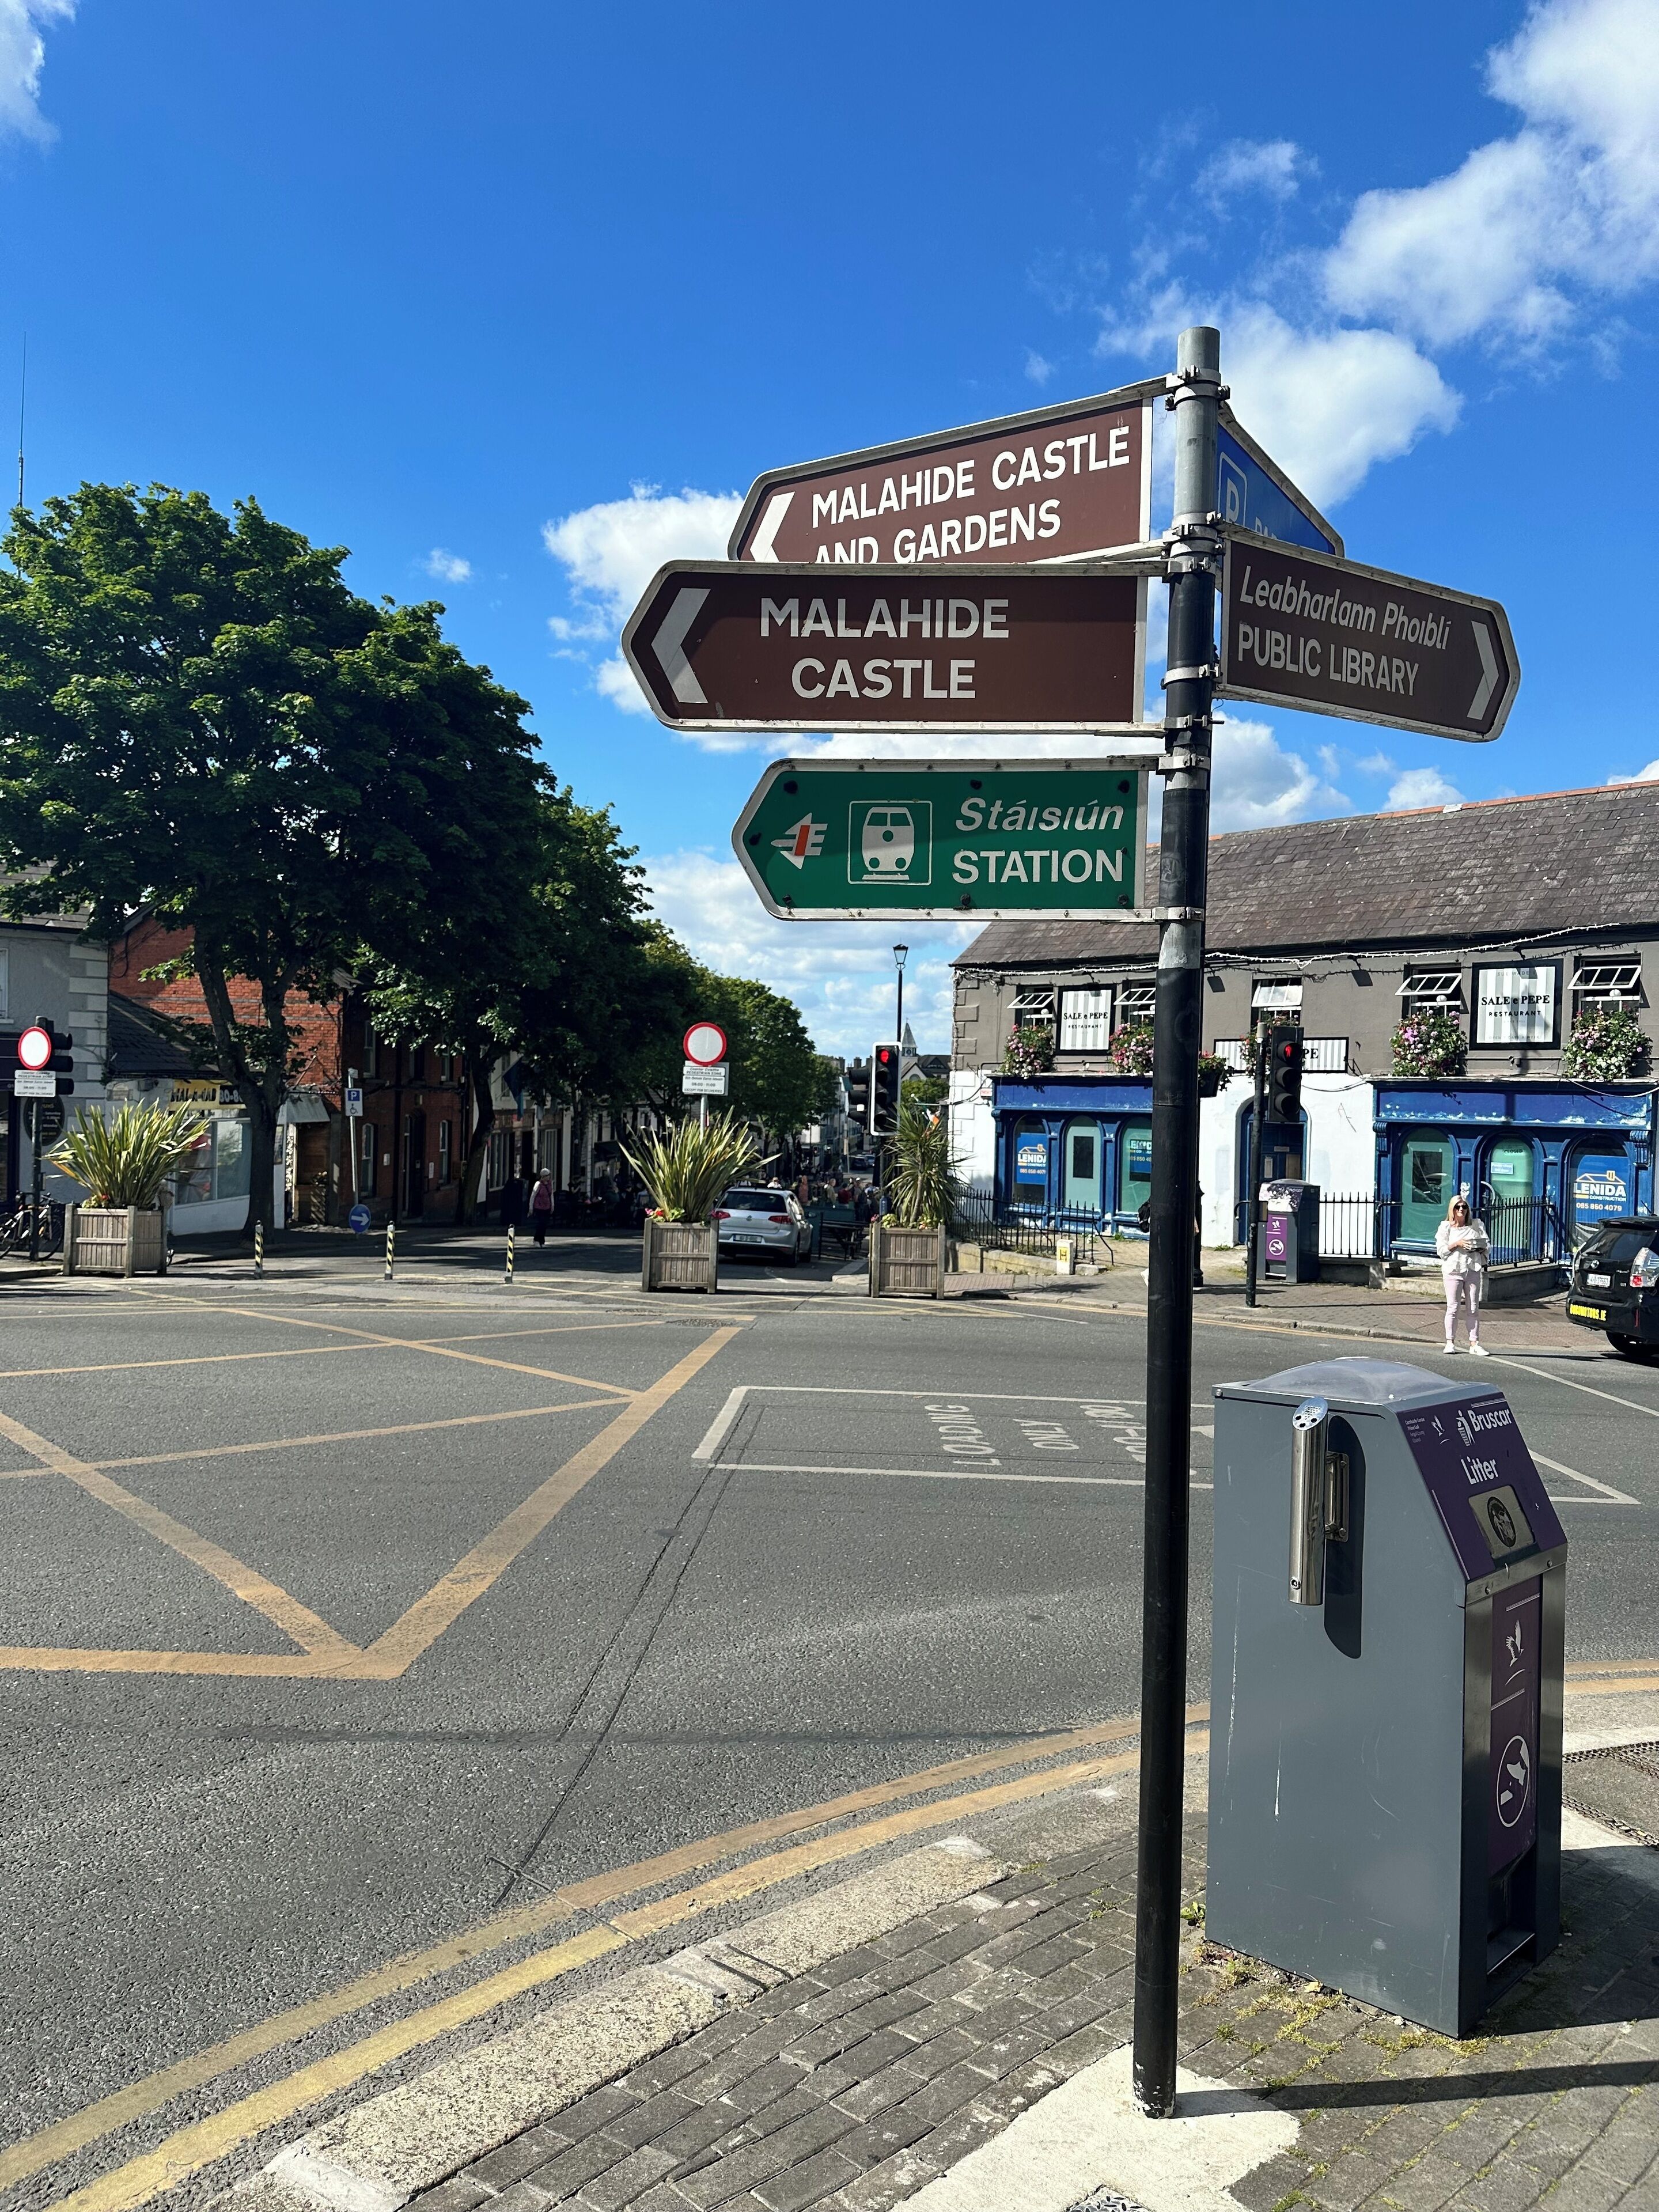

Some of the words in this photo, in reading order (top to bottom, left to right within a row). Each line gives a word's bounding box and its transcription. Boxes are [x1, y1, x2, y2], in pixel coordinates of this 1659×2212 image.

[812, 459, 975, 529] MALAHIDE
[991, 426, 1130, 490] CASTLE
[893, 499, 1060, 563] GARDENS
[1239, 565, 1376, 633] Leabharlann
[760, 599, 1010, 638] MALAHIDE
[1238, 623, 1321, 677] PUBLIC
[1329, 643, 1419, 696] LIBRARY
[791, 658, 976, 699] CASTLE
[952, 849, 1123, 884] STATION
[1481, 997, 1510, 1006] SALE
[1521, 995, 1550, 1004] PEPE
[1303, 1048, 1319, 1059] PE
[350, 1091, 357, 1100] P
[1573, 1183, 1627, 1197] LENIDA
[925, 1404, 1002, 1465] LOADING
[1012, 1418, 1080, 1450] ONLY
[1467, 1408, 1513, 1432] Bruscar
[1460, 1456, 1499, 1485] Litter
